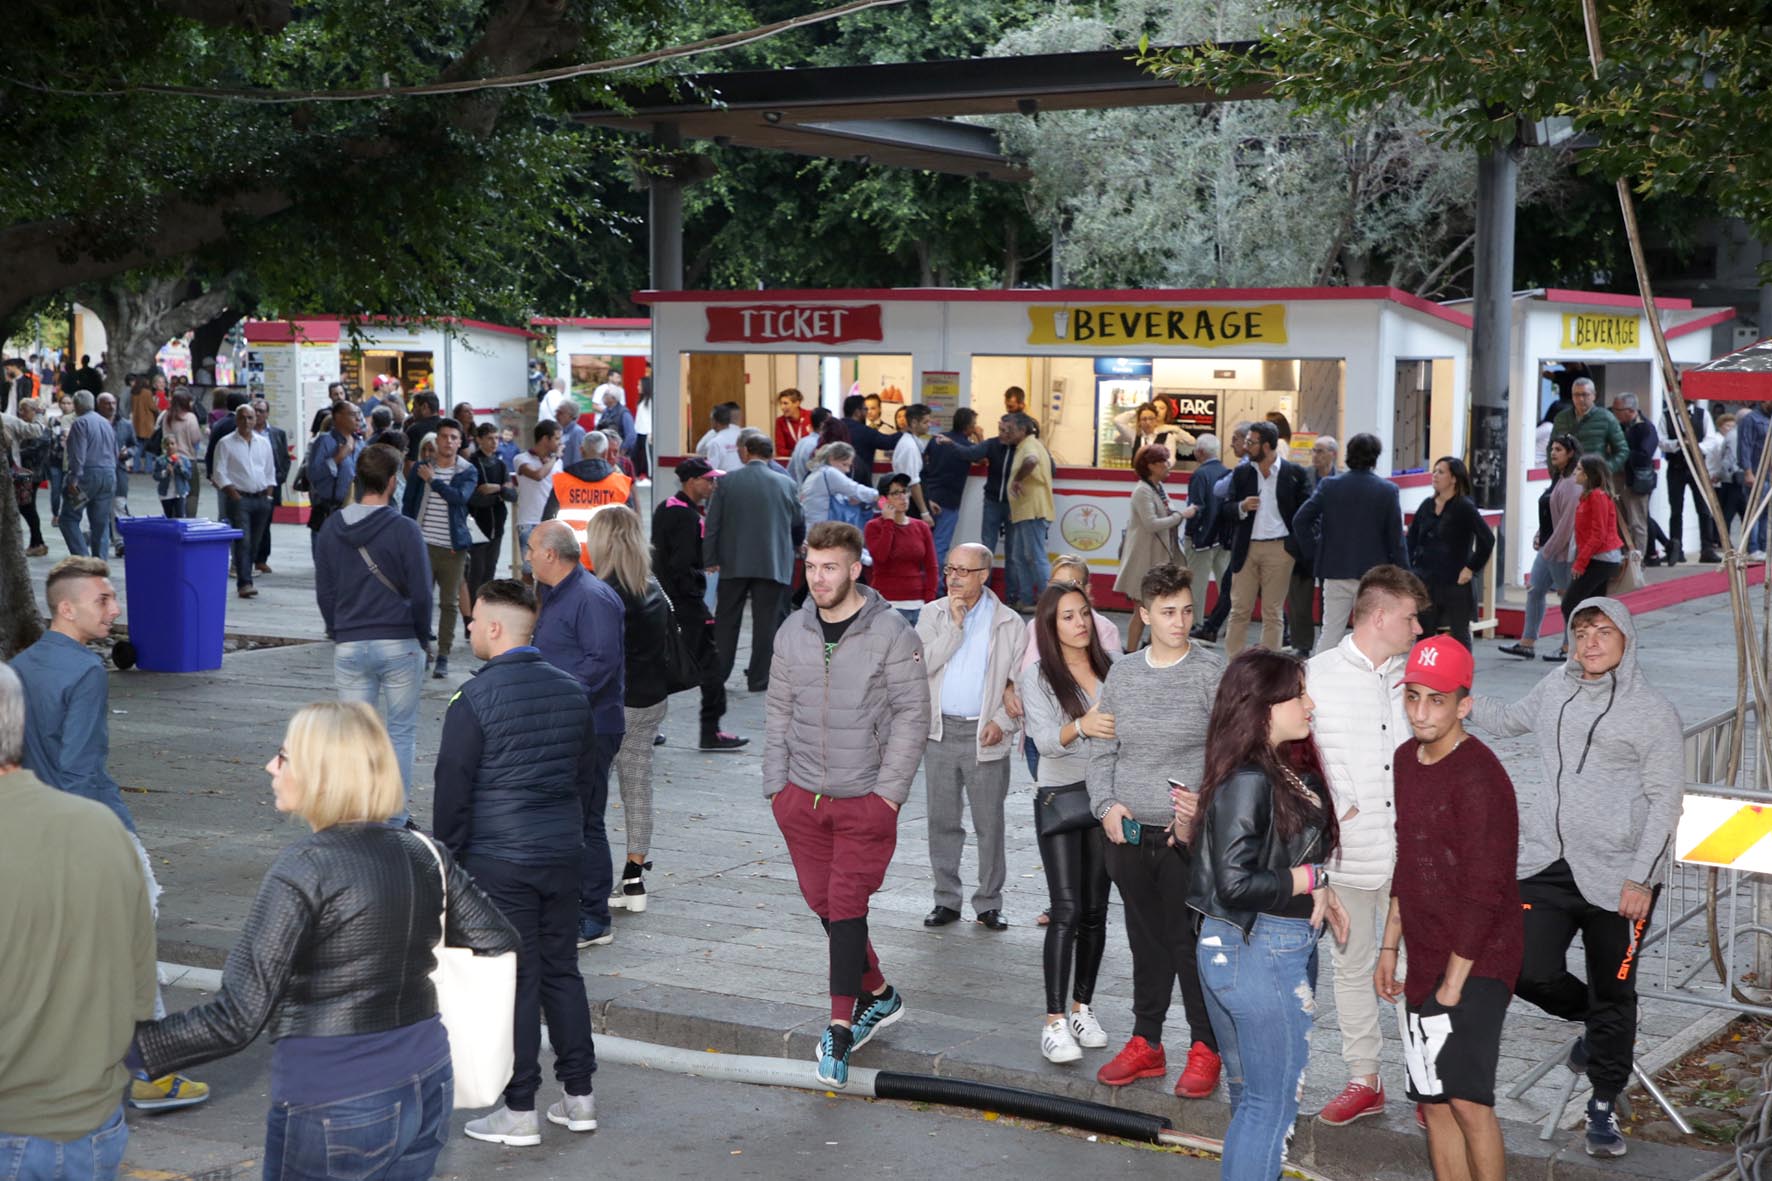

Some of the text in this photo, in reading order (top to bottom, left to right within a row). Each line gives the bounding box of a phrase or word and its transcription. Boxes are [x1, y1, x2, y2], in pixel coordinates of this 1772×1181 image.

[739, 308, 849, 338] TICKET
[1073, 308, 1264, 341] BEVERAGE
[1577, 315, 1635, 346] BEVERAGE
[1180, 399, 1215, 415] FARC
[569, 488, 615, 504] SECURITY
